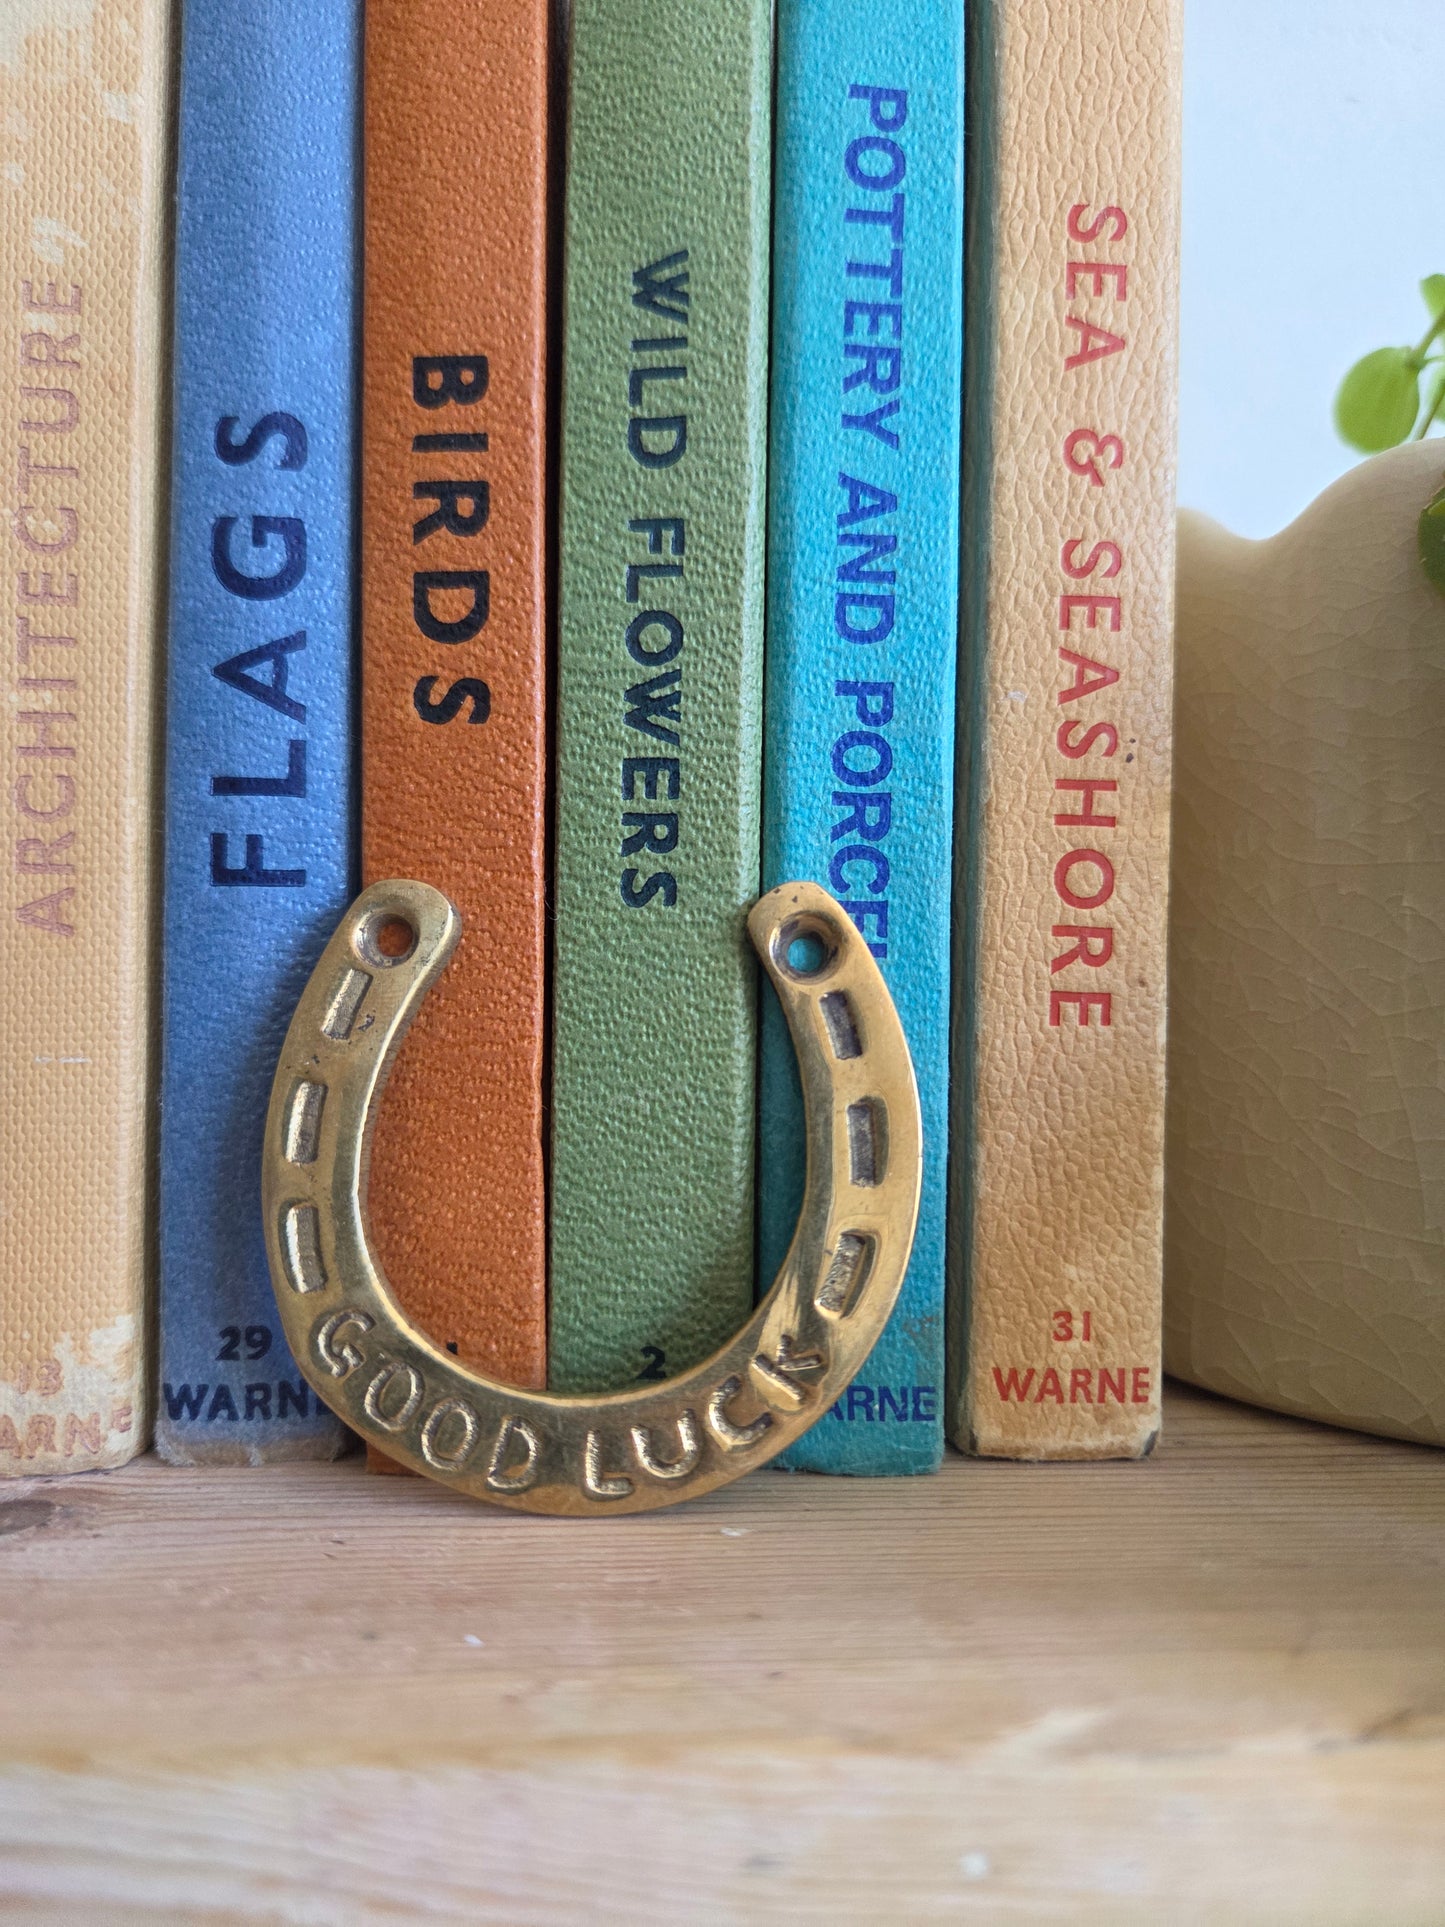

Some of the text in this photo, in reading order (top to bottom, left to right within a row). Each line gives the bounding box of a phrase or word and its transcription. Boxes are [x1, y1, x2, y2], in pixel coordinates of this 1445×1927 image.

[842, 84, 907, 448] POTTERY
[14, 281, 82, 938] ARCHITECTURE
[413, 355, 491, 724] BIRDS
[622, 250, 689, 907] WILD FLOWERS
[836, 473, 897, 644] AND
[1049, 204, 1128, 1026] SEA & SEASHORE
[210, 413, 306, 887] FLAGS
[216, 1325, 273, 1361] 29
[316, 1309, 823, 1498] GOOD LUCK
[635, 1345, 667, 1380] 2
[992, 1366, 1150, 1404] WARNE
[1052, 1310, 1090, 1342] 31
[0, 1405, 132, 1459] ARNE
